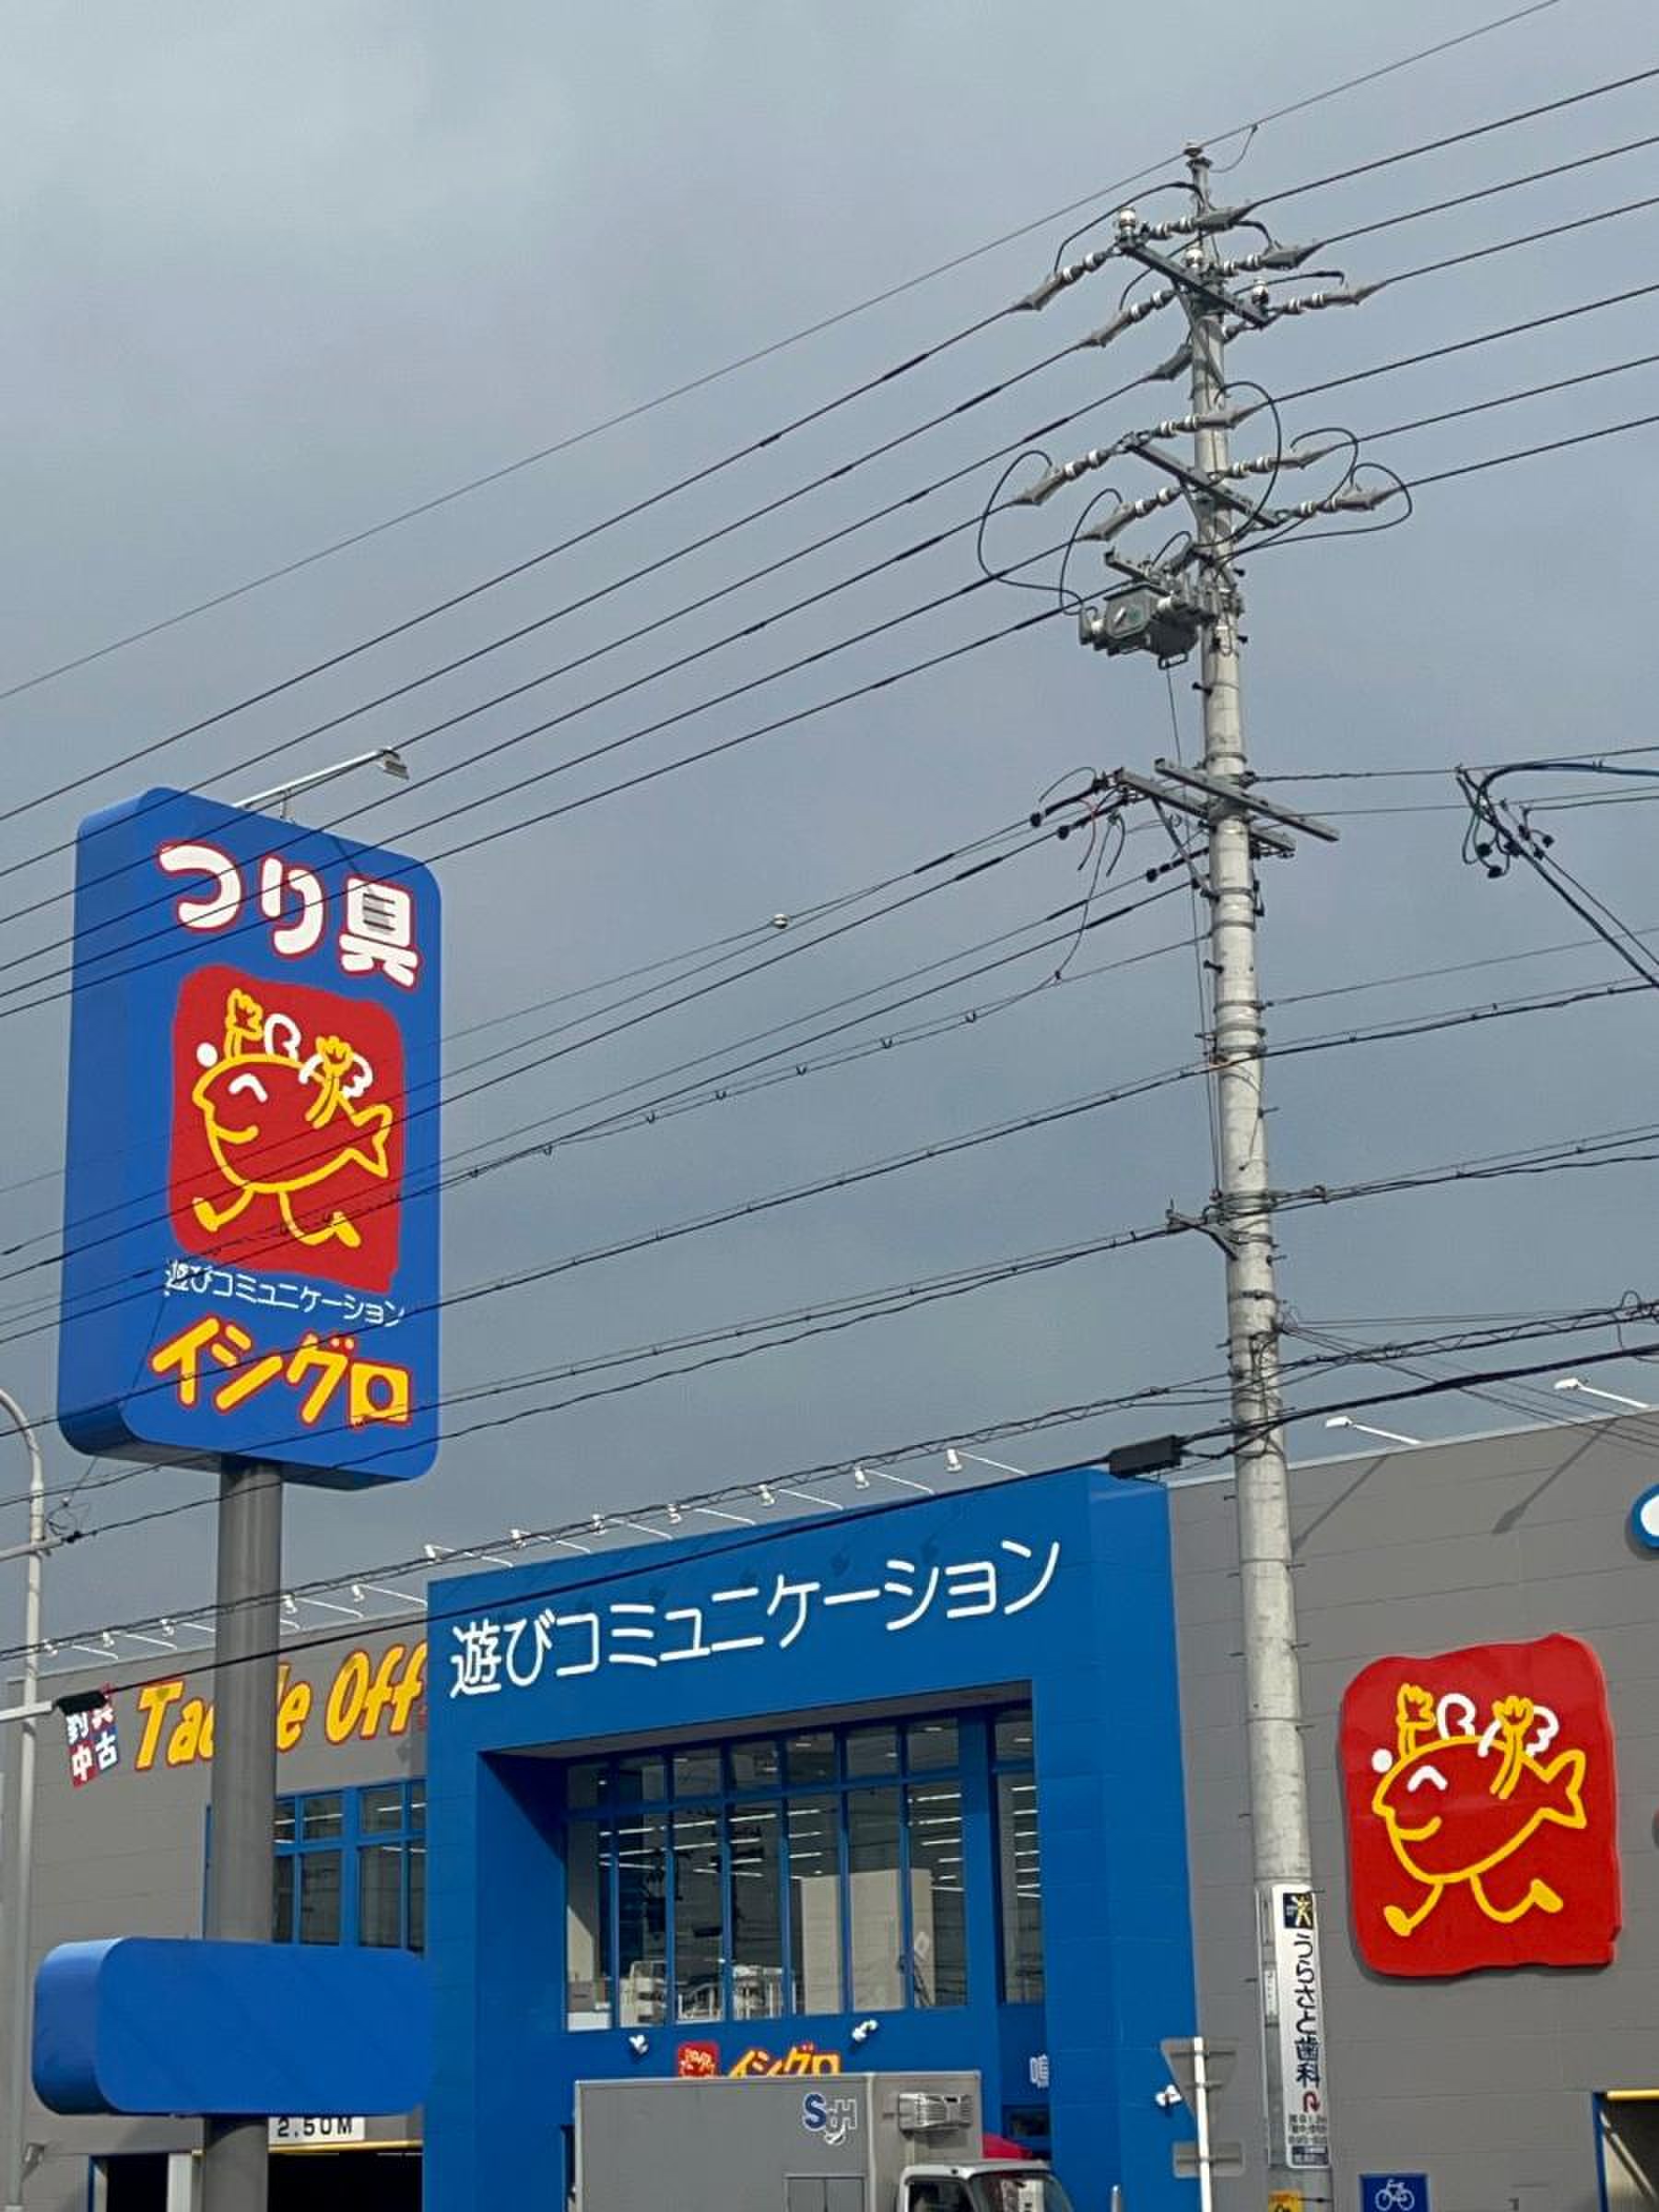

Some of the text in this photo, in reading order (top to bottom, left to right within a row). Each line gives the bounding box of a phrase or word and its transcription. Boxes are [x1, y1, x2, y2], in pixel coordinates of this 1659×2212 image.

[159, 844, 418, 988] つり具
[164, 1259, 405, 1328] 遊びコミュニケーション
[150, 1315, 410, 1427] イシグロ
[450, 1540, 1060, 1698] 遊びコミュニケーション
[325, 1639, 428, 1744] Off
[1293, 1932, 1321, 2089] うらさと歯科
[277, 2117, 353, 2137] 2.50M
